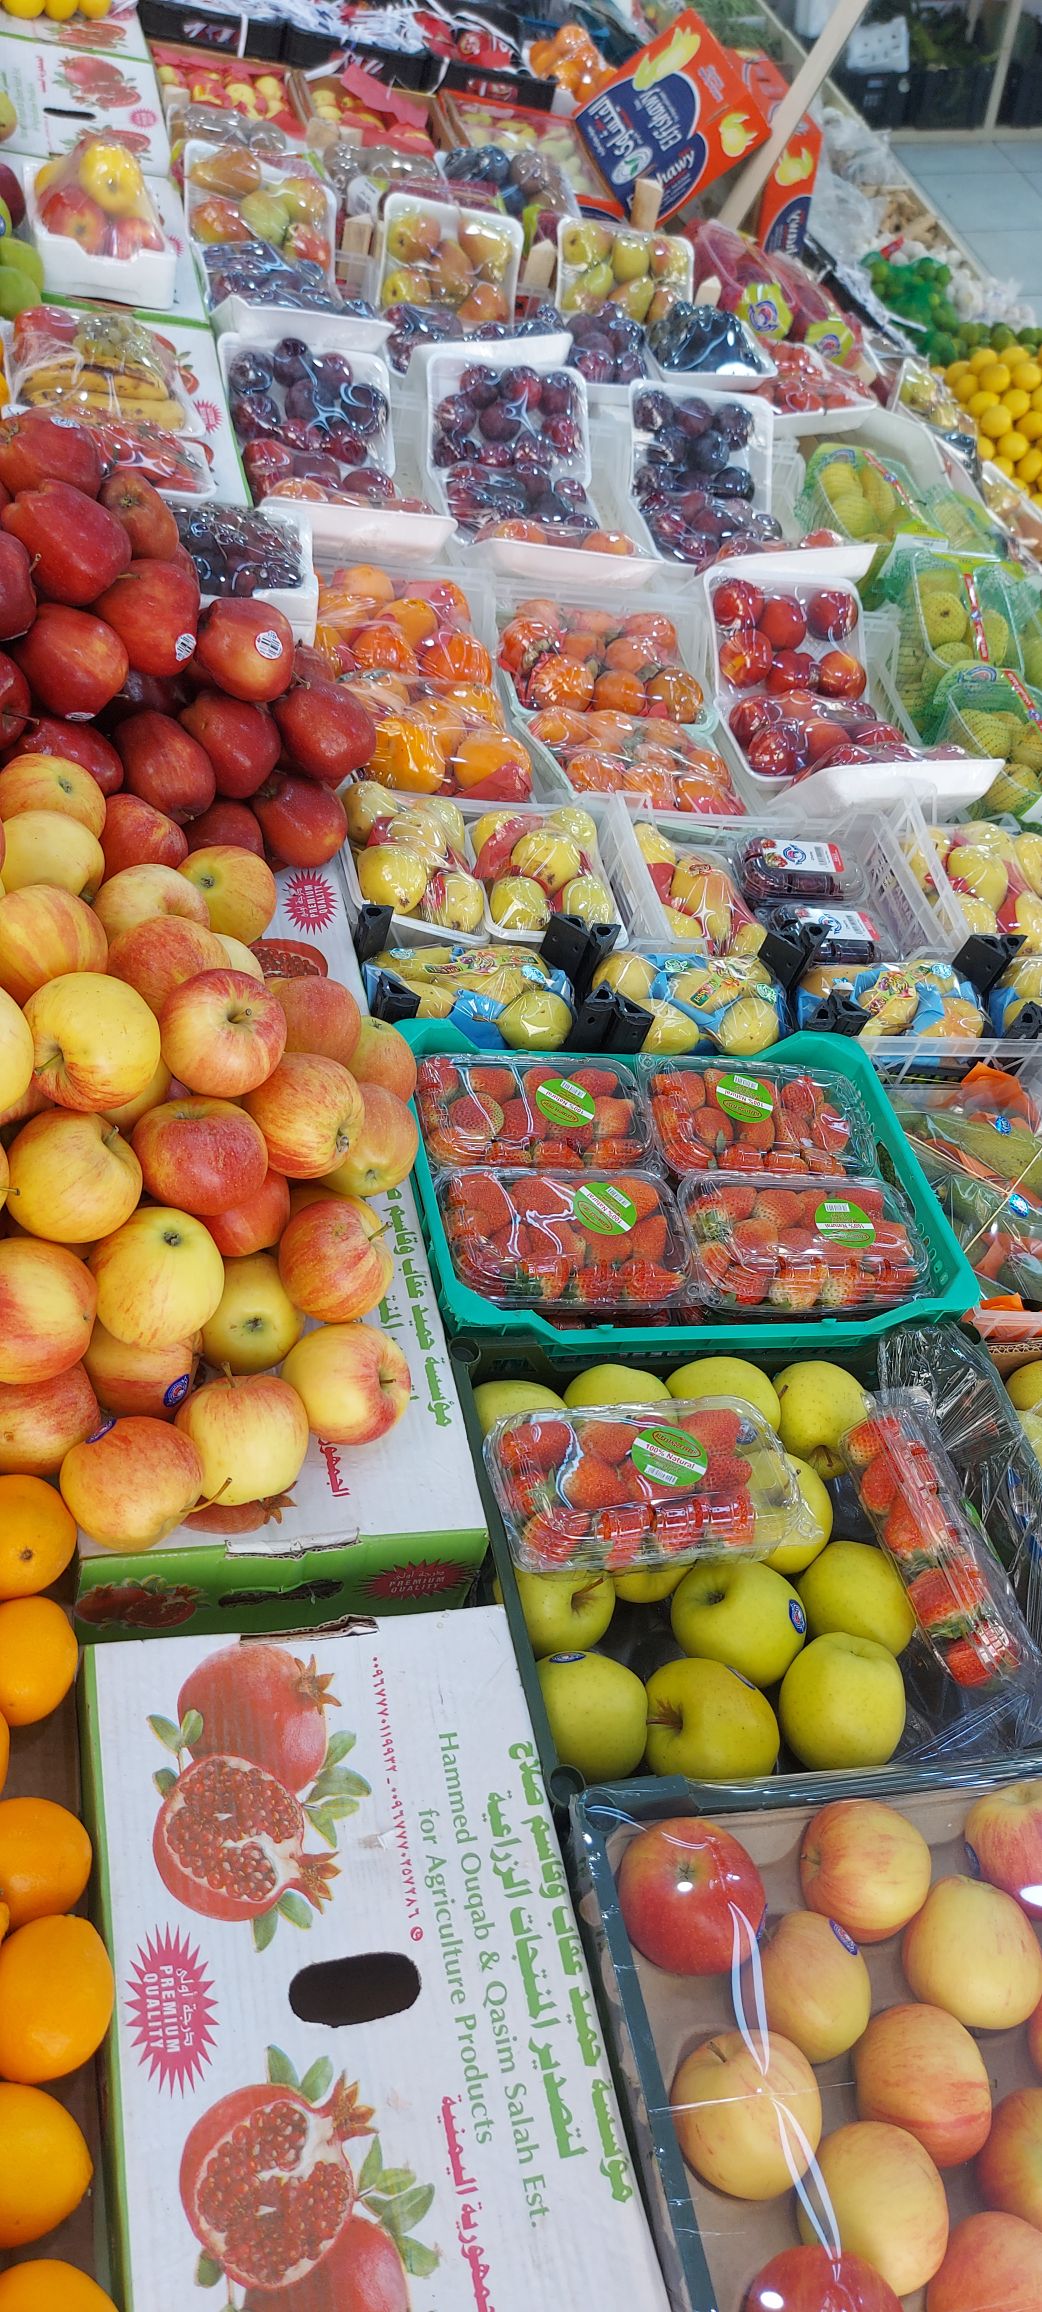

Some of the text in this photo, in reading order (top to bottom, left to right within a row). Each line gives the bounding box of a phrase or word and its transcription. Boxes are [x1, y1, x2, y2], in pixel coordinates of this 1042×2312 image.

[639, 88, 682, 152] Elfishawy
[304, 885, 319, 918] PREMIUM
[314, 885, 328, 914] QUALITY
[545, 1091, 567, 1105] Natural
[724, 1090, 764, 1107] 100% Natural
[382, 1204, 418, 1256] وقاسم
[587, 1193, 608, 1211] Natural
[608, 1211, 622, 1224] 100%
[398, 1258, 428, 1299] عقاب
[409, 1304, 435, 1351] حميد
[424, 1356, 455, 1427] مؤسسة
[646, 1444, 665, 1456] 100%
[666, 1453, 695, 1469] Natural
[389, 1576, 446, 1587] PREMIUM
[390, 1583, 439, 1593] QUALITY
[508, 1740, 545, 1806] صلاح
[418, 1808, 495, 2145] for Agriculture Products
[438, 1732, 550, 2228] Hammed Ouqab & Qasim Salah Est.
[481, 1789, 588, 2160] لتصدير المنتجات الزراعية
[143, 1972, 164, 2048] QUALITY
[160, 1965, 181, 2052] PREMIUM
[176, 1968, 198, 2046] درجة أولى
[565, 1986, 601, 2067] حميد
[437, 2094, 480, 2195] اليمنية
[592, 2078, 633, 2203] مؤسسة
